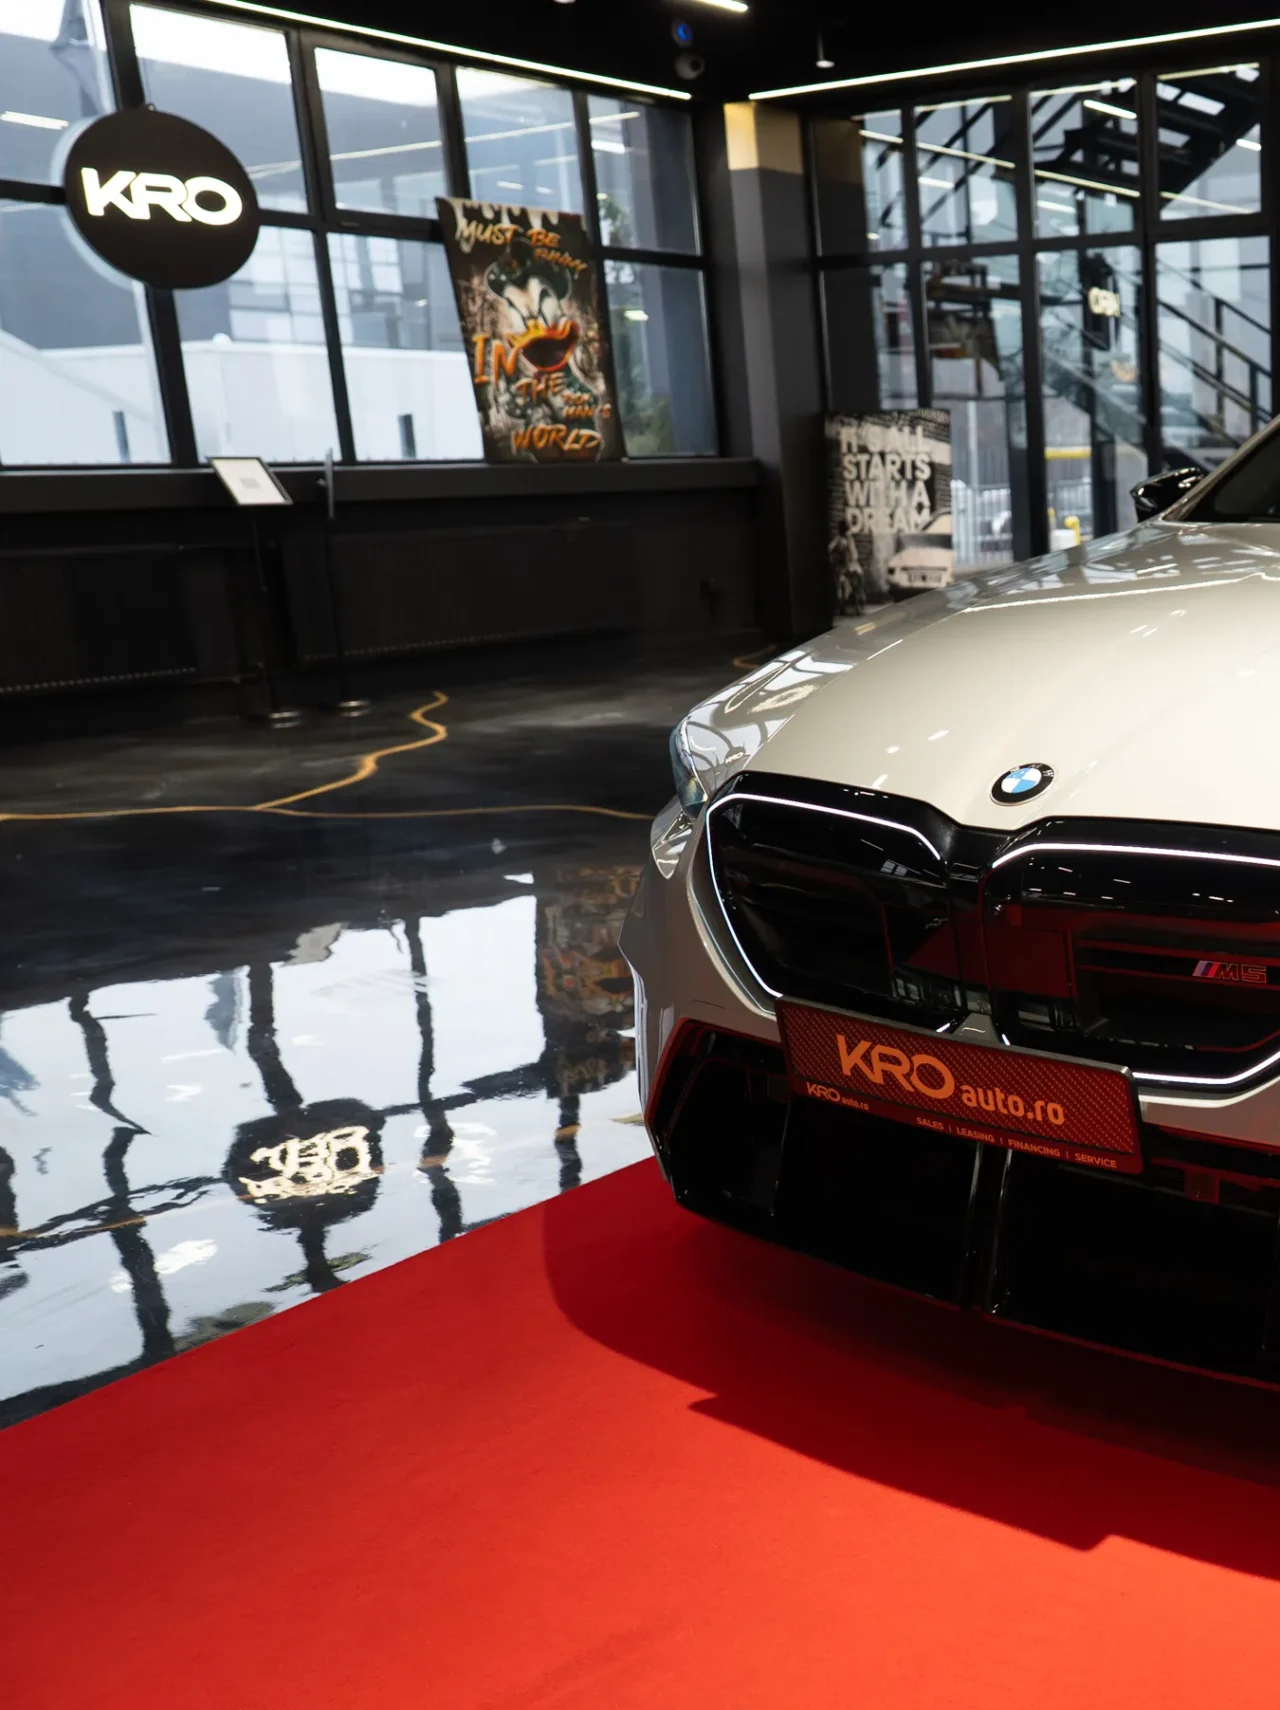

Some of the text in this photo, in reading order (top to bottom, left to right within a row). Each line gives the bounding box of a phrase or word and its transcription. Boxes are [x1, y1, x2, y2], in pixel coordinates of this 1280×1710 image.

[81, 167, 243, 226] KRO
[456, 220, 561, 252] MUST BE
[472, 333, 522, 385] IN
[515, 373, 566, 402] THE
[512, 423, 602, 451] WORLD
[842, 452, 932, 481] STARTS
[911, 480, 931, 507] A
[846, 507, 932, 535] DREAM
[806, 1081, 841, 1102] KRO
[836, 1034, 1065, 1126] KRO auto.ro
[916, 1116, 1117, 1169] SALES LEASING FINANCING SERVICE
